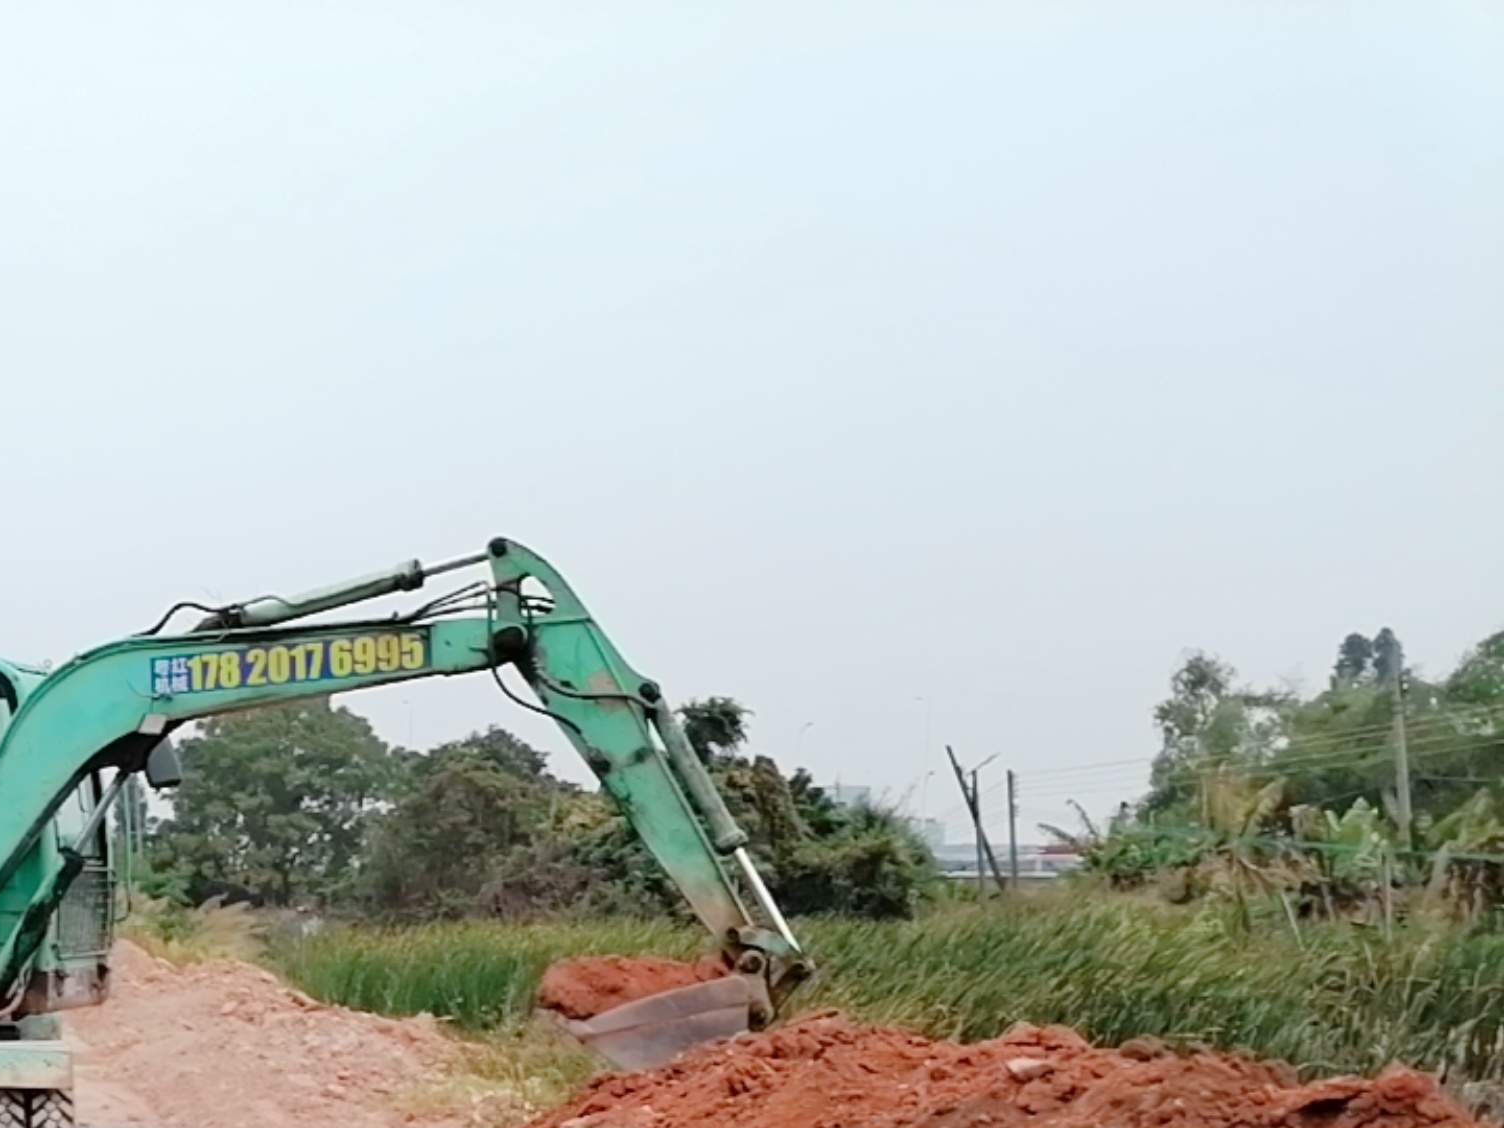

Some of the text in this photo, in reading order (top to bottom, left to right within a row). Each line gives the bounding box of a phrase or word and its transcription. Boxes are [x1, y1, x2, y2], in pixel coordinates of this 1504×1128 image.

[188, 634, 425, 691] 178 2017 6995
